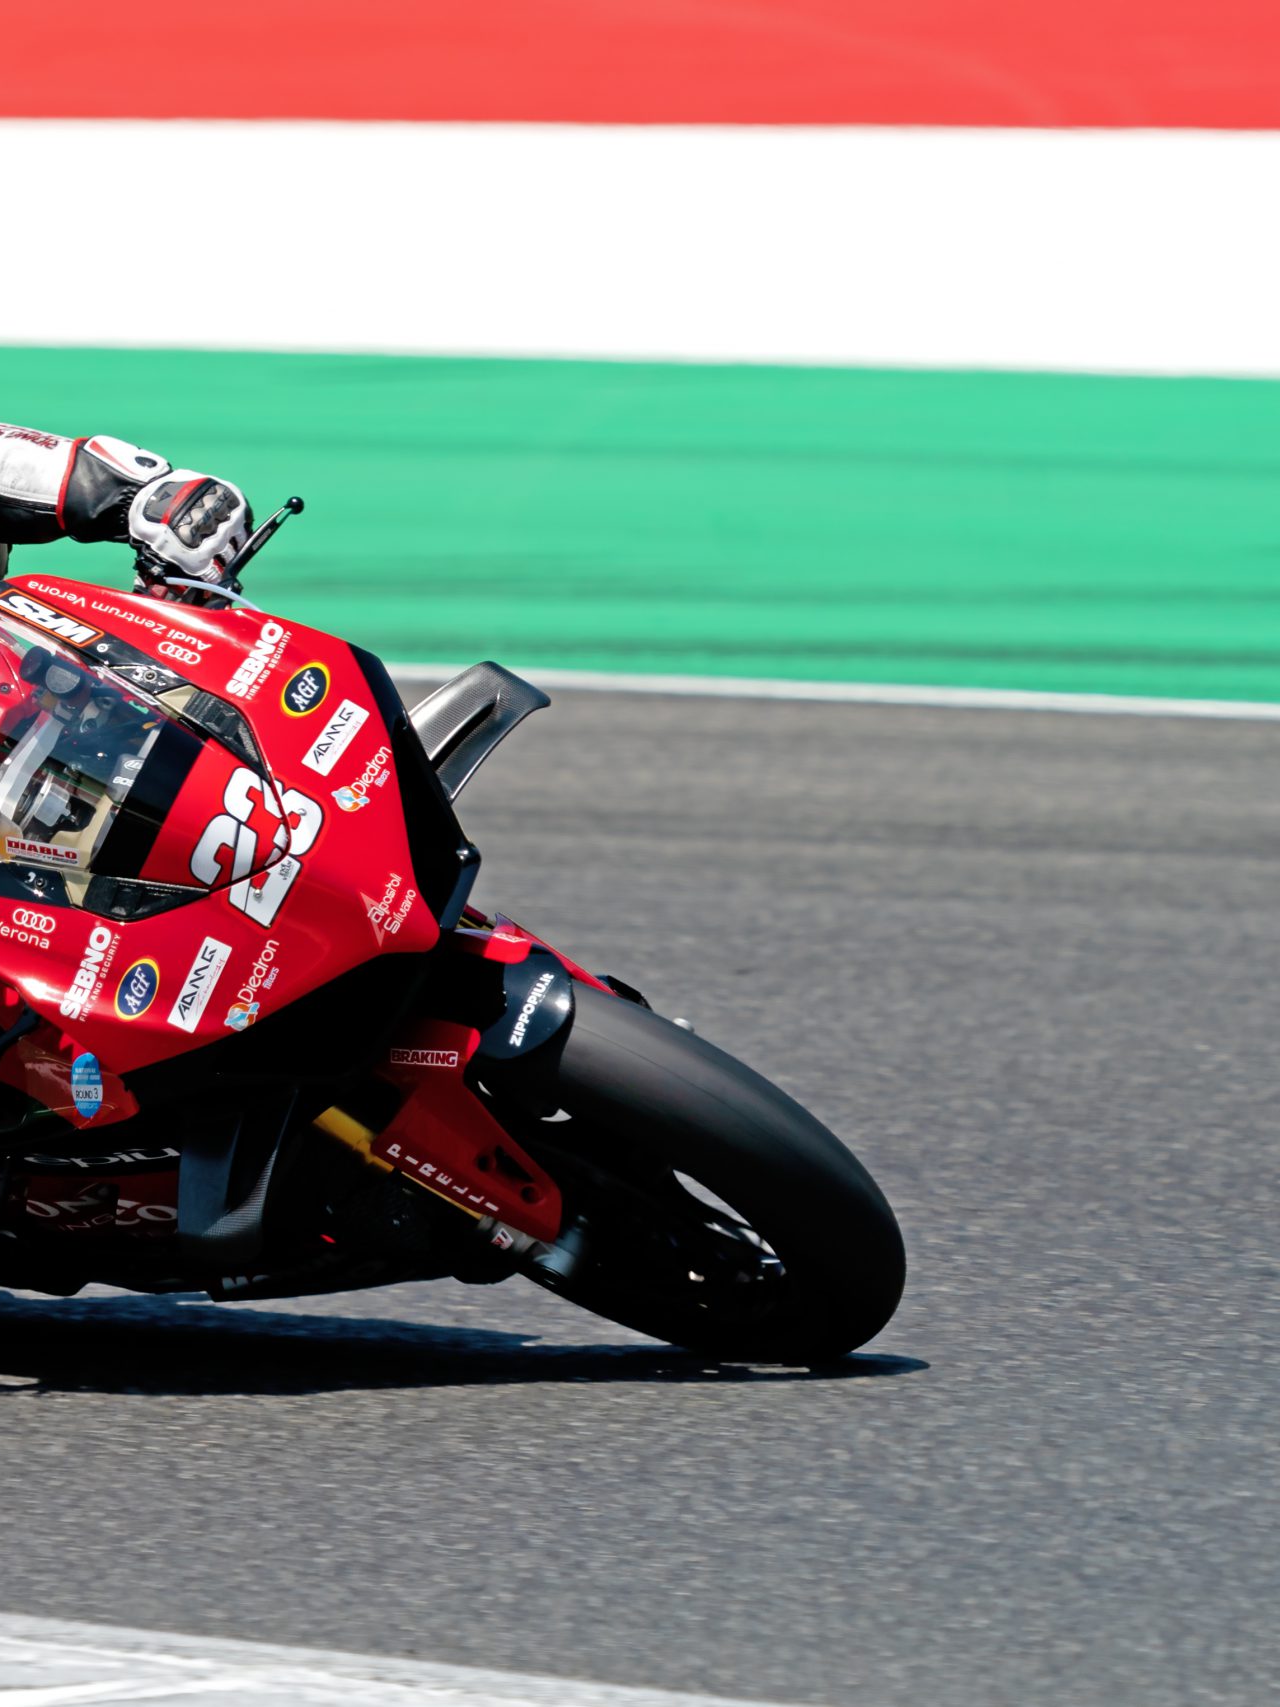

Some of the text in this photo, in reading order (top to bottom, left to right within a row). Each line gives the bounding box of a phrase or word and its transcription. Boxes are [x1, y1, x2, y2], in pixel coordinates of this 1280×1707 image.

[27, 581, 212, 652] Audi Zentrum Verona
[246, 630, 293, 701] FIRE AND SECURITY
[290, 670, 320, 711] AGF
[350, 745, 391, 797] Diedron
[7, 839, 77, 860] DIABLO
[190, 766, 325, 929] 23
[79, 933, 121, 1023] FIRE AND SECURITY
[125, 966, 152, 1013] AGF
[237, 939, 280, 1003] Diedron
[262, 967, 280, 989] filters
[391, 1050, 458, 1067] BRAKING
[75, 1089, 93, 1100] ROUND
[386, 1143, 499, 1213] PIRELLI
